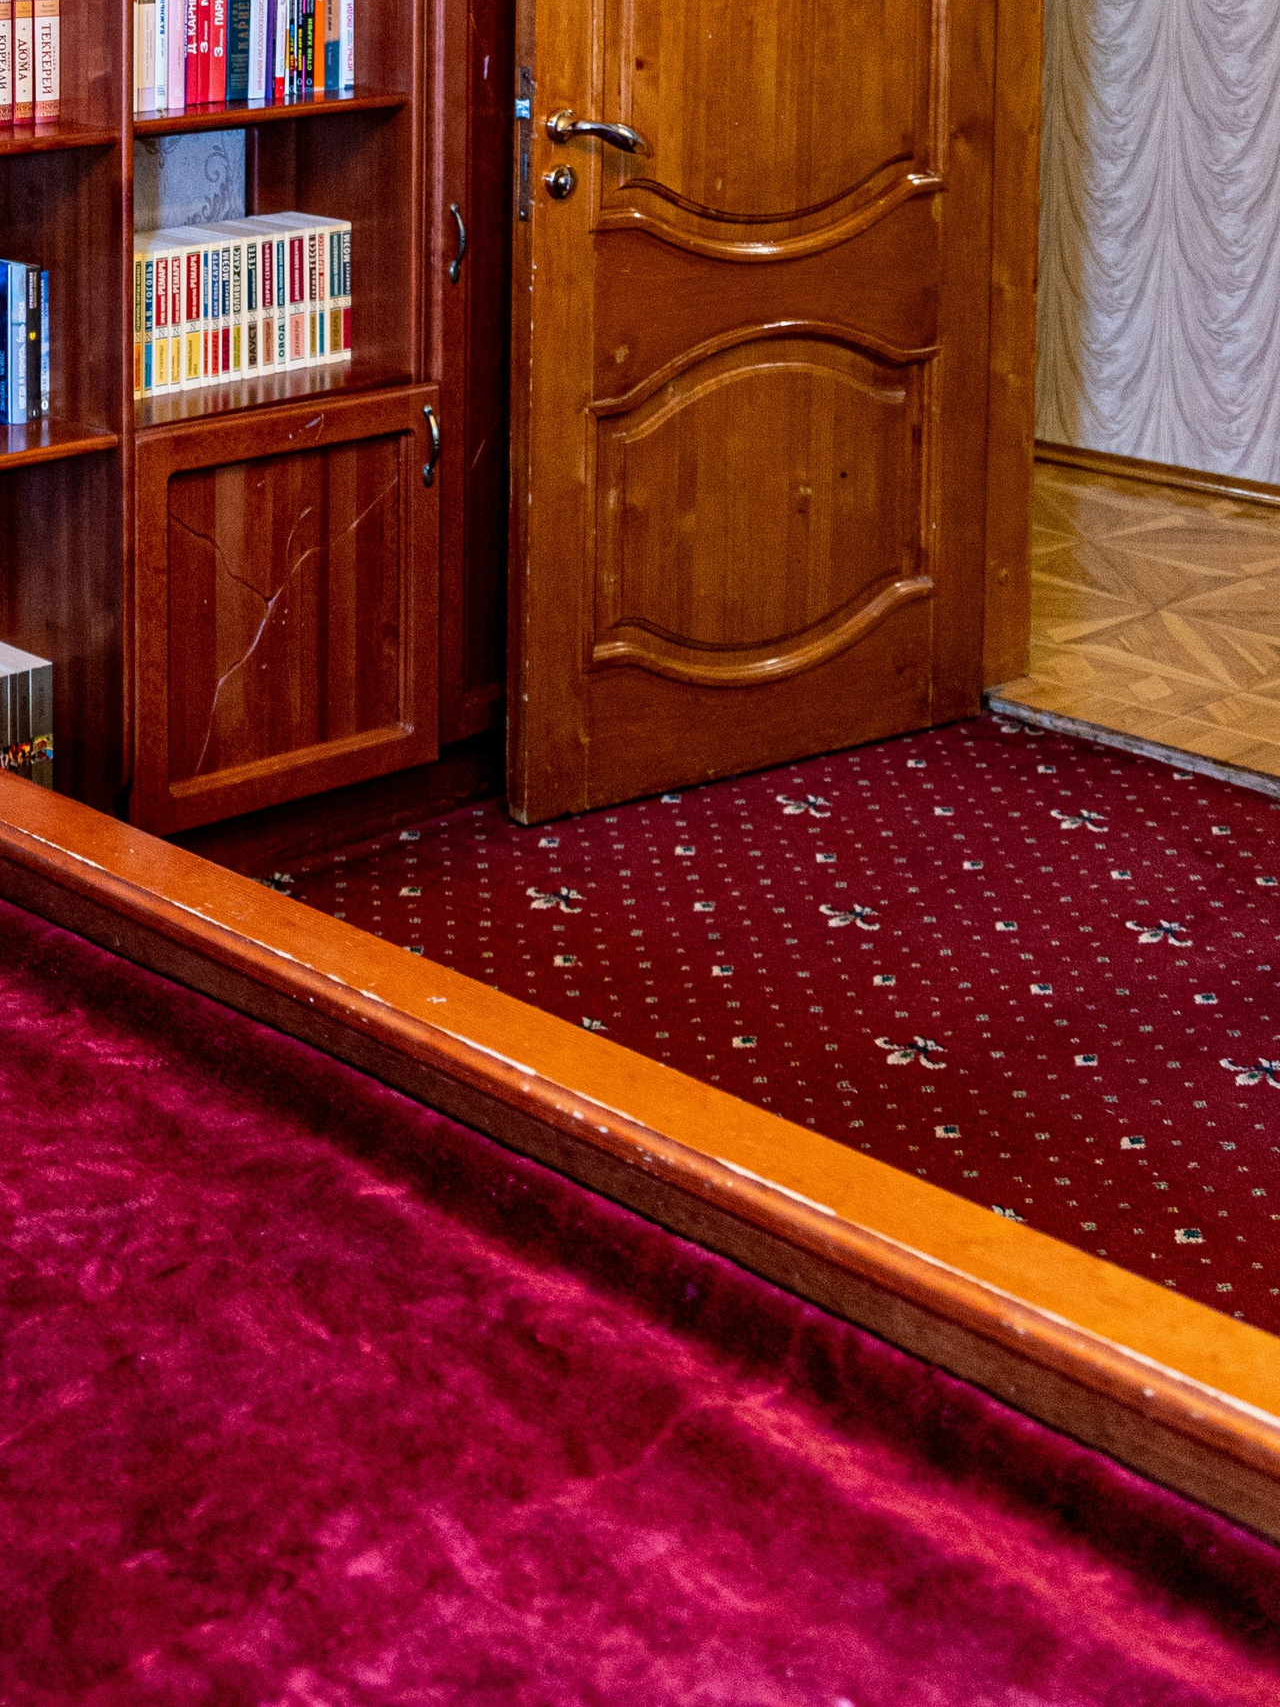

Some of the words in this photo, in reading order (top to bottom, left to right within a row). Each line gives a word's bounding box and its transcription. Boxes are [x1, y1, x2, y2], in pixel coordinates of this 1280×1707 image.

[17, 39, 28, 81] ДЮМА
[40, 23, 54, 94] ТЕККЕРЕЙ
[343, 234, 351, 263] МОЭМ
[158, 261, 166, 295] РЕМАРК
[190, 255, 198, 288] РЕМАРК
[222, 252, 230, 281] МОЭМ
[248, 325, 257, 365] ФАУСТ
